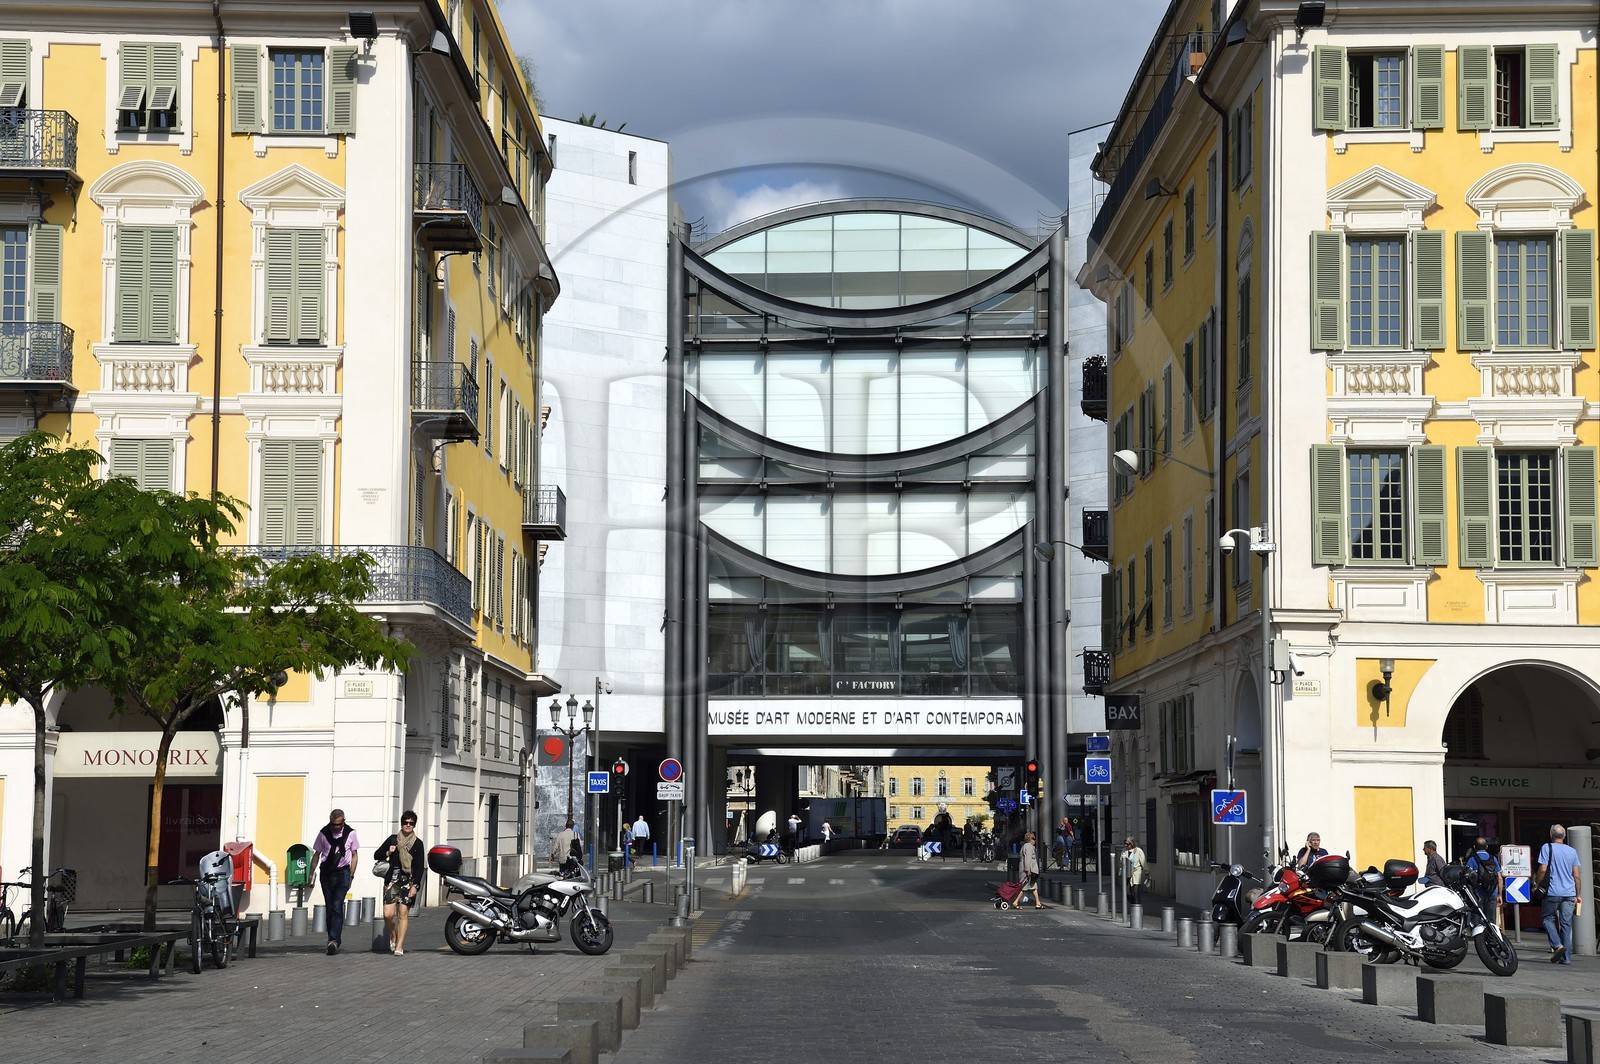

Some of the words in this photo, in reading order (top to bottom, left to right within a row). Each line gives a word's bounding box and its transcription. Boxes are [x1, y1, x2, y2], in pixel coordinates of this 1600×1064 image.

[852, 681, 896, 690] FACTORY
[708, 709, 749, 725] MUSÉE
[756, 711, 790, 725] D'ART
[796, 711, 856, 725] MODERNE
[862, 711, 878, 725] ET
[884, 711, 920, 725] D'ART
[926, 711, 1025, 725] CONTEMPORAIN
[1108, 706, 1138, 720] BAX
[83, 749, 209, 766] MONORIX
[1469, 776, 1530, 788] SERVICE
[165, 815, 218, 825] livraison
